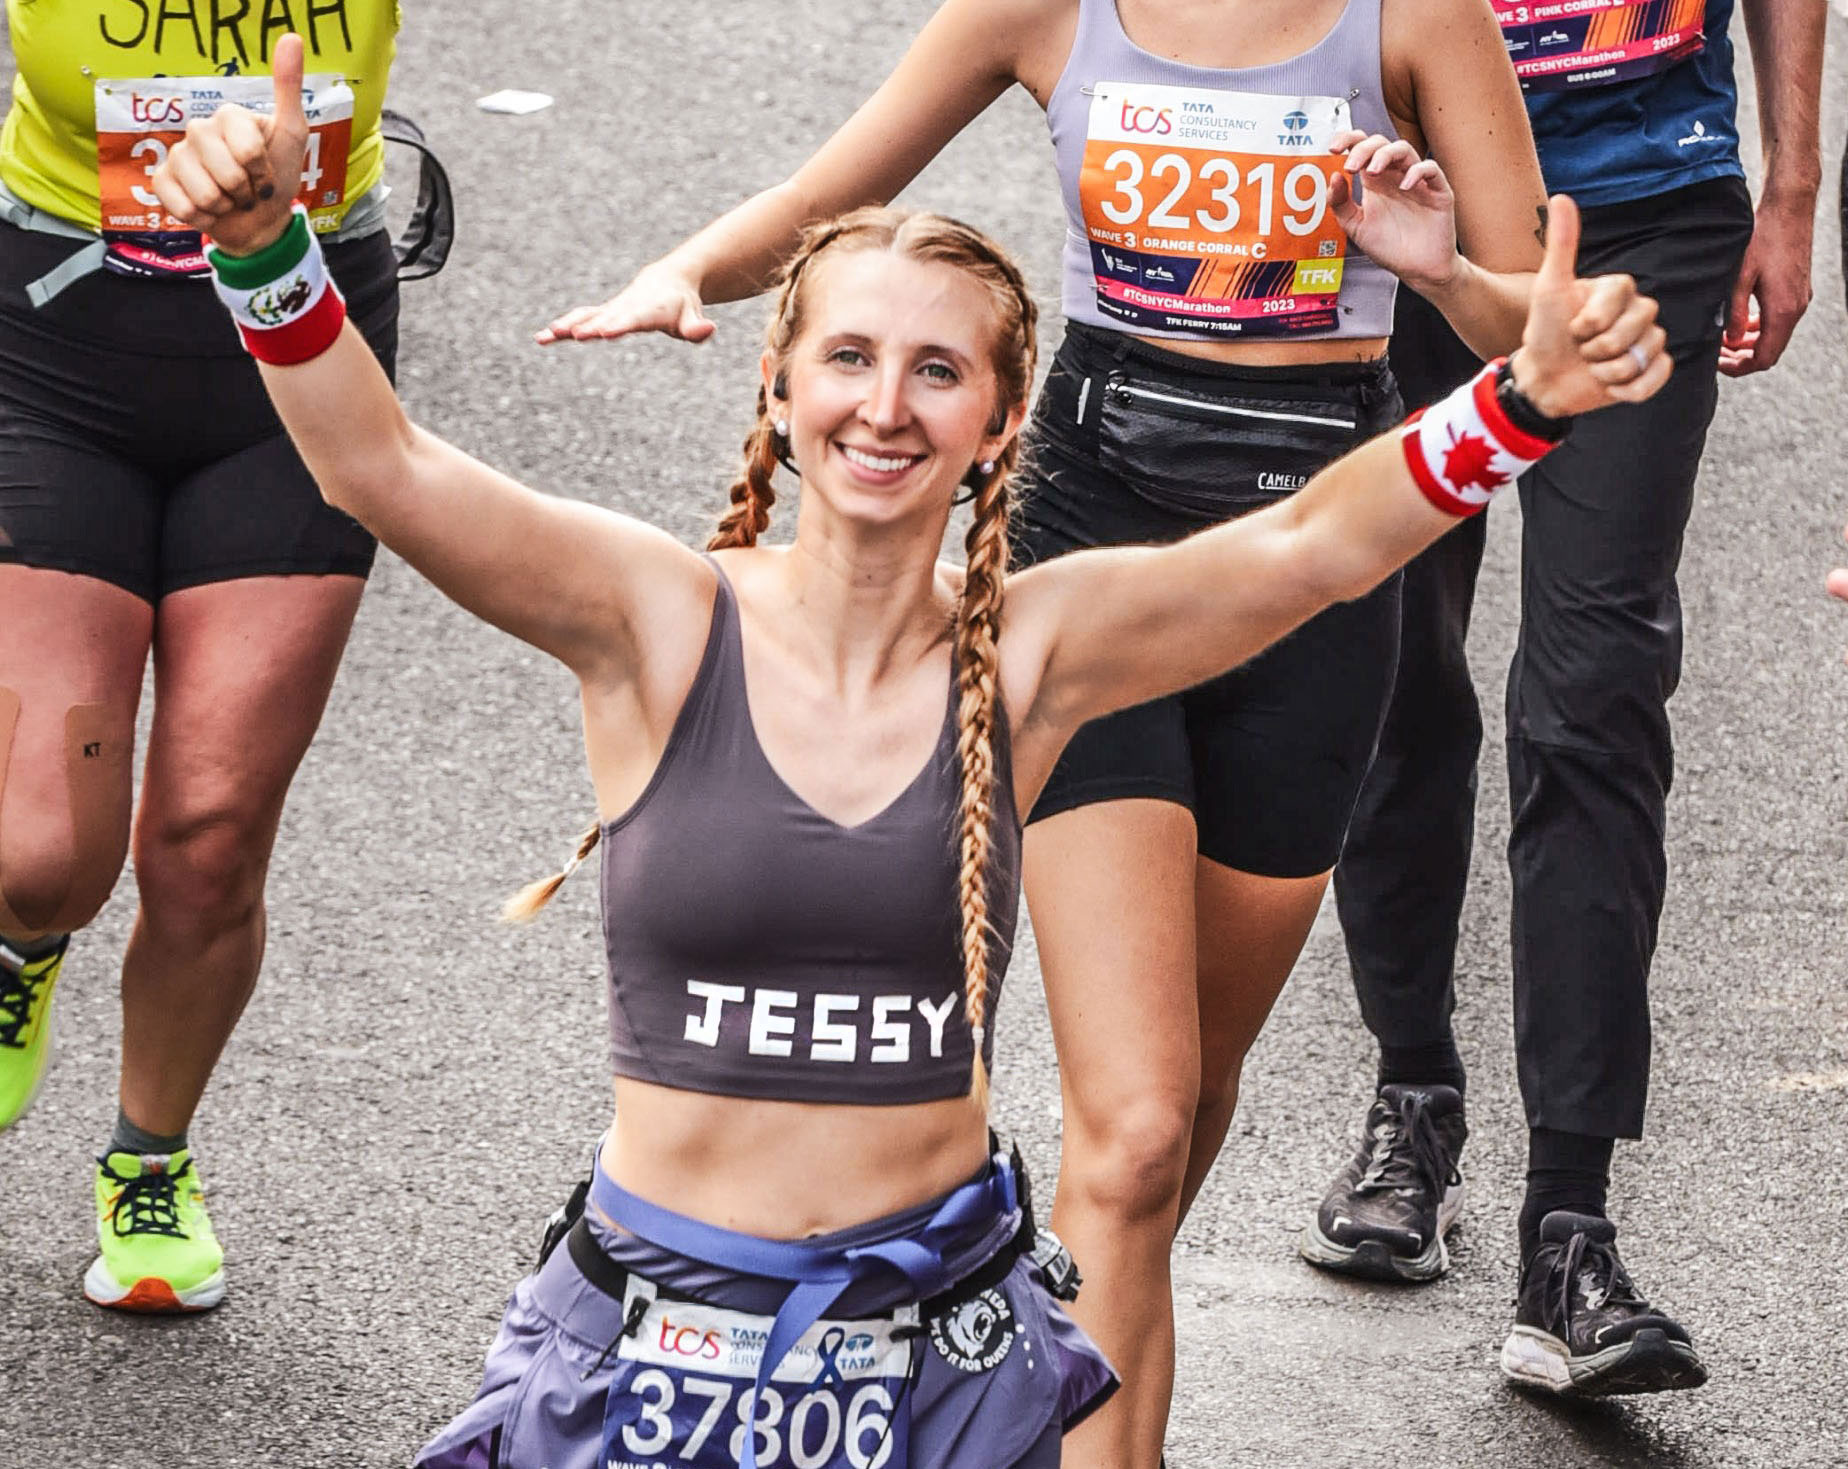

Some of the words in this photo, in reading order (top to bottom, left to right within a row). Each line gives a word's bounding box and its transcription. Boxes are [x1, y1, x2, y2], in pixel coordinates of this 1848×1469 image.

[1515, 7, 1529, 22] 3
[1535, 5, 1563, 17] PINK
[100, 0, 353, 67] SARAH
[1652, 34, 1681, 51] 2023
[1517, 50, 1626, 74] #TCSNYCMarathon
[191, 90, 223, 99] TATA
[132, 92, 184, 122] tcs
[1182, 102, 1214, 113] TATA
[1121, 98, 1173, 135] tcs
[1179, 115, 1257, 130] CONSULTANCY
[1178, 127, 1229, 141] SERVICES
[1277, 134, 1313, 146] TATA
[1100, 149, 1327, 237] 32319
[108, 215, 145, 226] WAVE
[147, 212, 161, 229] 3
[1091, 227, 1123, 243] WAVE
[1124, 231, 1137, 248] 3
[1143, 237, 1195, 251] ORANGE
[1197, 240, 1249, 256] CORRAL
[1251, 242, 1267, 259] C
[1300, 268, 1337, 284] TFK
[1123, 288, 1232, 314] #TCSNYCMarathon
[1262, 298, 1296, 313] 2023
[1258, 472, 1307, 489] CAMELB
[84, 742, 101, 757] KT
[684, 979, 958, 1063] JESSY
[659, 1316, 722, 1359] tcs
[731, 1327, 769, 1341] TATA
[840, 1357, 876, 1370] TATA
[621, 1368, 894, 1469] 37806
